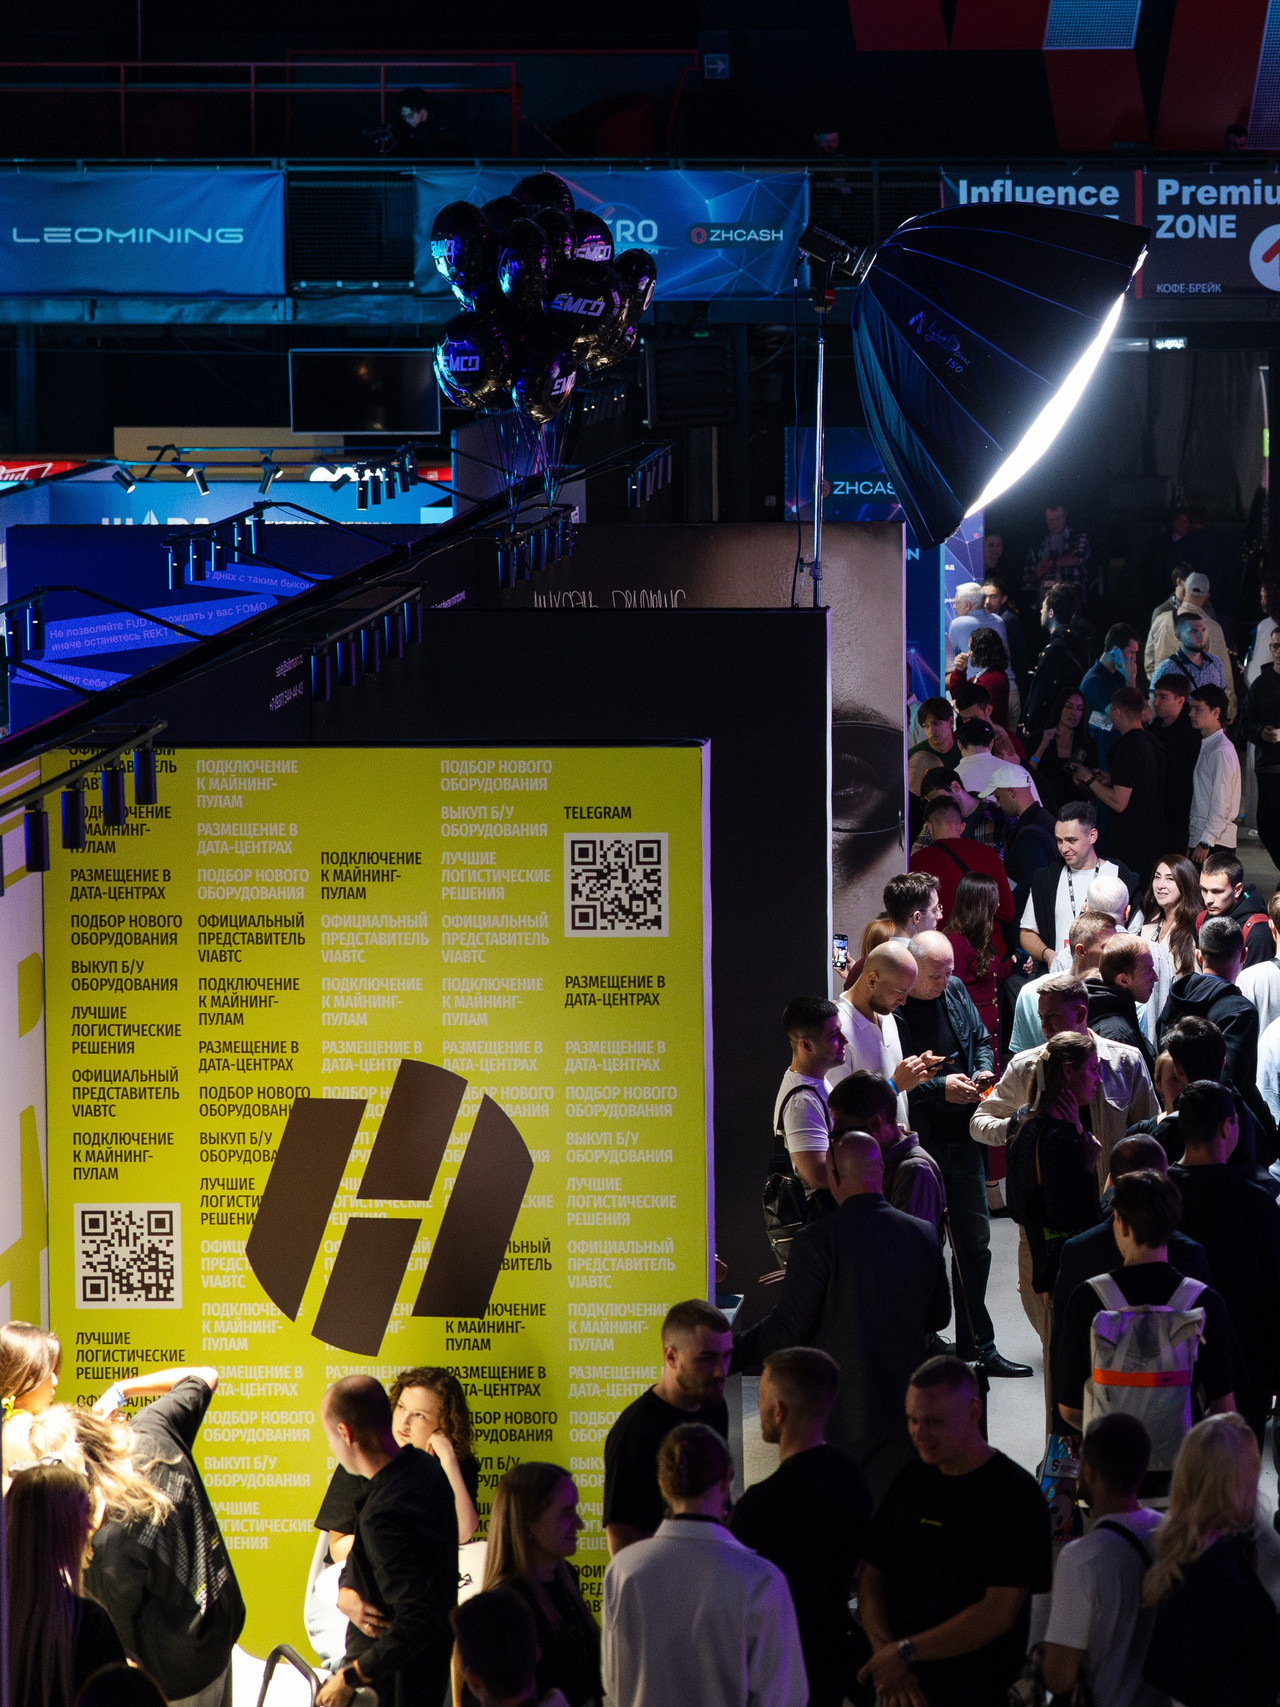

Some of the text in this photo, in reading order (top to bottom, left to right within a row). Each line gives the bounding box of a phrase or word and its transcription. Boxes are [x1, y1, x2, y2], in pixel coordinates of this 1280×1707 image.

[959, 179, 1119, 204] Influence
[1156, 215, 1236, 239] ZONE
[13, 228, 244, 244] LEOMINING
[710, 229, 783, 242] ZHCASH
[1157, 283, 1221, 294] КОФЕ-БРЕЙК
[946, 358, 963, 373] 150
[833, 482, 896, 494] ZHCAS
[50, 630, 64, 639] Не
[126, 618, 147, 630] FUD
[143, 628, 168, 639] REKT
[441, 760, 552, 776] ПОДБОР НОВОГО
[441, 778, 547, 793] ОБОРУДОВАНИЯ
[565, 806, 631, 819] TELEGRAM
[198, 823, 298, 838] РАЗМЕЩЕНИЕ В
[197, 841, 292, 856] ДАТА-ЦЕНТРАХ
[321, 852, 421, 868] ПОДКЛЮЧЕНИЕ
[441, 852, 496, 865] ЛУЧШИЕ
[71, 869, 171, 883] РАЗМЕЩЕНИЕ В
[321, 865, 400, 882] К МАЙНИНГ-
[441, 869, 551, 882] ЛОГИСТИЧЕСКИЕ
[70, 886, 165, 902] ДАТА-ЦЕНТРАХ
[321, 887, 366, 899] ПУЛАМ
[442, 887, 504, 900] РЕШЕНИЯ
[71, 915, 182, 930] ПОДБОР НОВОГО
[198, 912, 304, 929] ОФИЦИАЛЬНЫЙ
[71, 932, 177, 947] ОБОРУДОВАНИЯ
[198, 932, 305, 947] ПРЕДСТАВИТЕЛЬ
[198, 950, 241, 962] VIABTC
[72, 959, 144, 975] ВЫКУП Б/У
[71, 978, 177, 993] ОБОРУДОВАНИЯ
[199, 978, 299, 994] ПОДКЛЮЧЕНИЕ
[566, 976, 665, 990] РАЗМЕЩЕНИЕ В
[199, 991, 278, 1008] К МАЙНИНГ-
[565, 993, 659, 1008] ДАТА-ЦЕНТРАХ
[72, 1006, 126, 1019] ЛУЧШИЕ
[199, 1013, 244, 1025] ПУЛАМ
[72, 1024, 180, 1036] ЛОГИСТИЧЕСКИЕ
[72, 1041, 134, 1054] РЕШЕНИЯ
[199, 1041, 299, 1056] РАЗМЕЩЕНИЕ В
[198, 1058, 293, 1073] ДАТА-ЦЕНТРАХ
[72, 1067, 178, 1083] ОФИЦИАЛЬНЫЙ
[73, 1087, 179, 1102] ПРЕДСТАВИТЕЛЬ
[72, 1104, 116, 1117] VIABTC
[73, 1132, 173, 1148] ПОДКЛЮЧЕНИЕ
[73, 1145, 153, 1162] К МАЙНИНГ-
[74, 1167, 118, 1180] ПУЛАМ
[200, 1178, 254, 1190] ЛУЧШИЕ
[567, 1238, 674, 1256] ОФИЦИАЛЬНЫЙ
[568, 1258, 675, 1273] ПРЕДСТАВИТЕЛЬ
[568, 1275, 612, 1288] VIABTC
[76, 1332, 130, 1345] ЛУЧШИЕ
[76, 1349, 184, 1362] ЛОГИСТИЧЕСКИЕ
[201, 1411, 315, 1429] ПОДБОР НОВОГО
[204, 1429, 310, 1444] ОБОРУДОВАНИЯ
